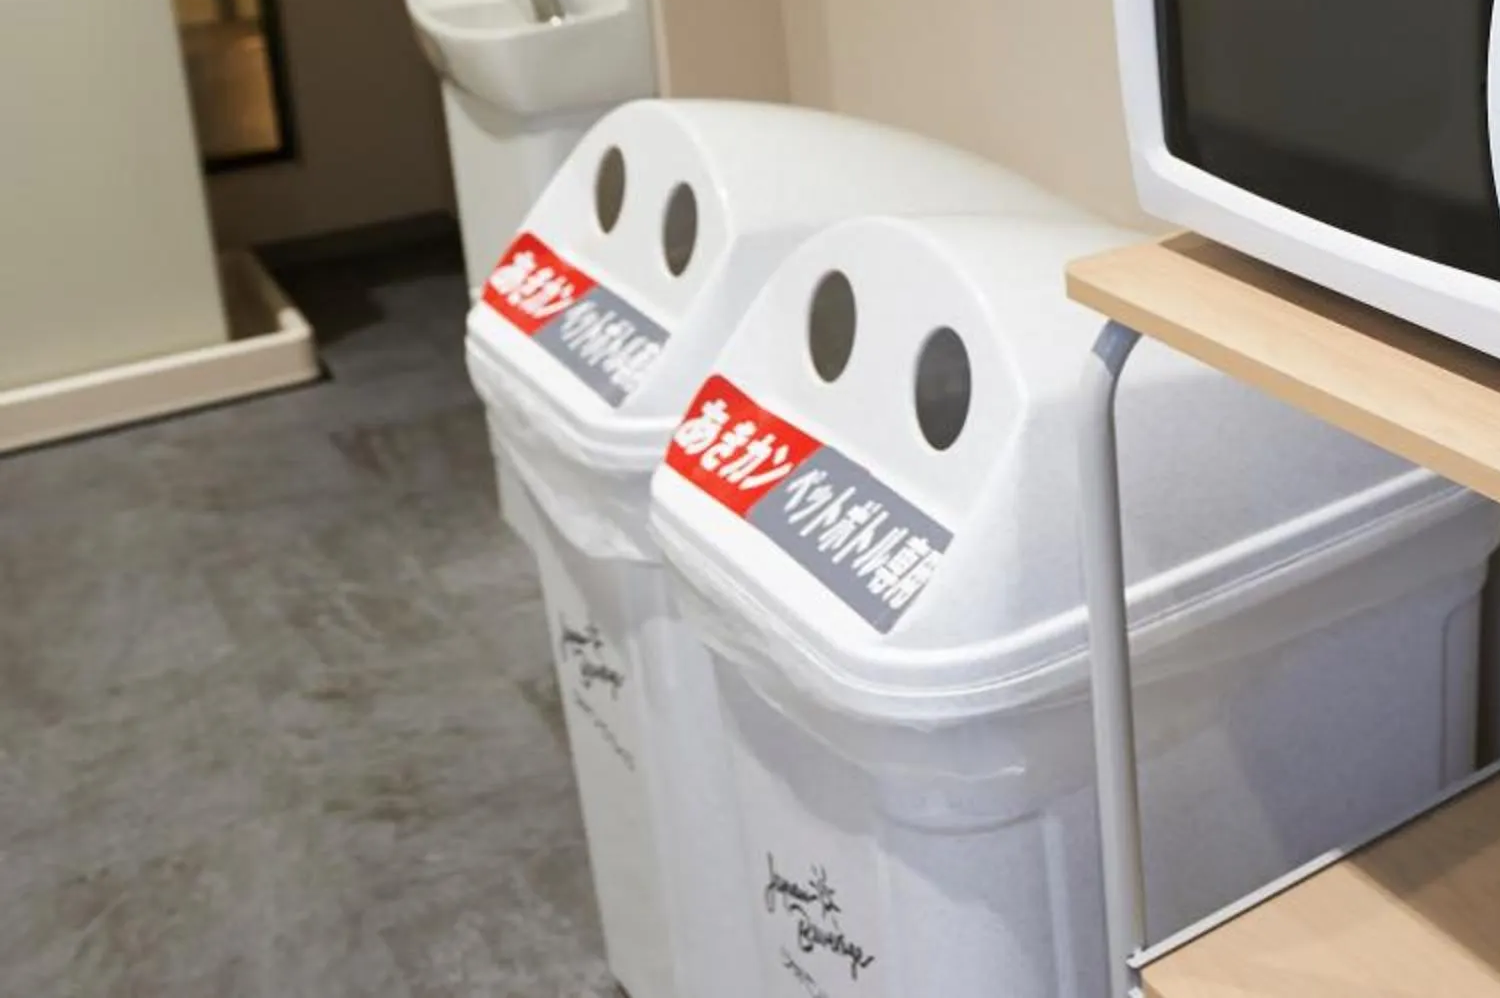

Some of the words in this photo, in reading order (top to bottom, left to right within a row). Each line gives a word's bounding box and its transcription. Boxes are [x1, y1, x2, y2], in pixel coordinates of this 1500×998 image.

[490, 250, 575, 319] あきカン
[675, 398, 795, 490] あきカン
